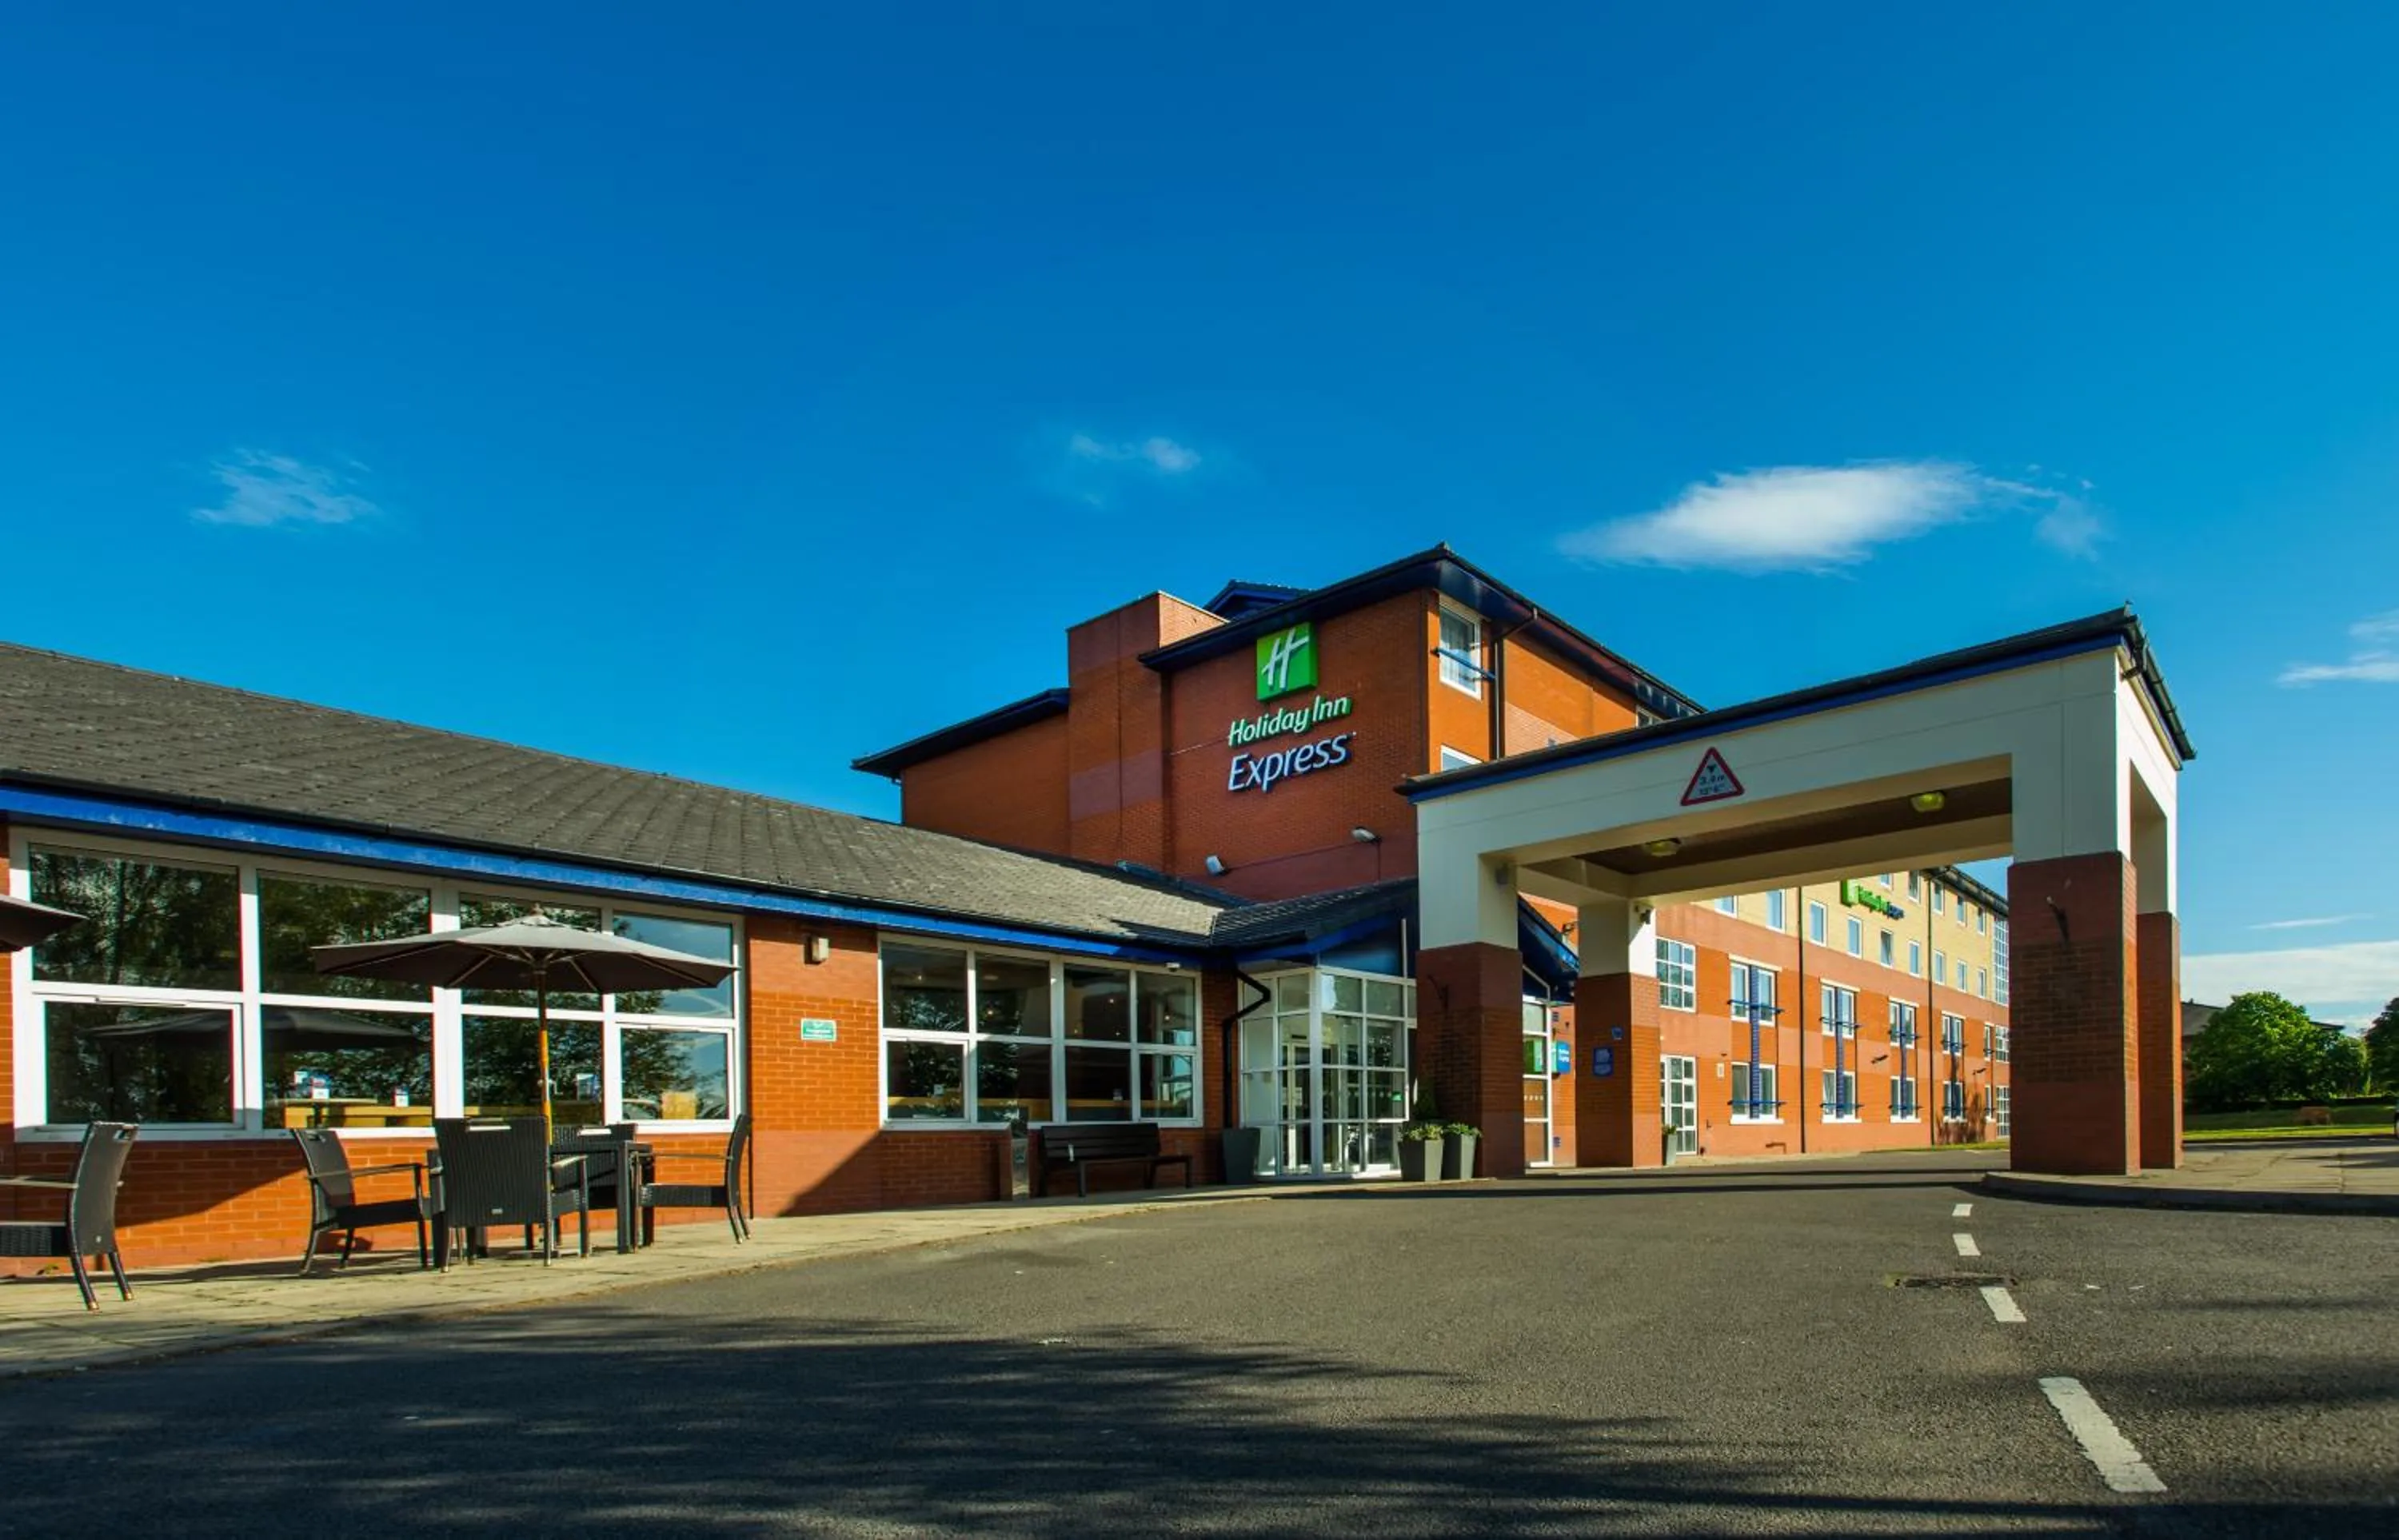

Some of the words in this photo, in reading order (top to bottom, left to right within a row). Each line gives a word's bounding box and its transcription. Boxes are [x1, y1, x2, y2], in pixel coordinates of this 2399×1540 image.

[1228, 708, 1310, 747] Holiday
[1312, 695, 1349, 723] Inn
[1228, 734, 1348, 792] Express
